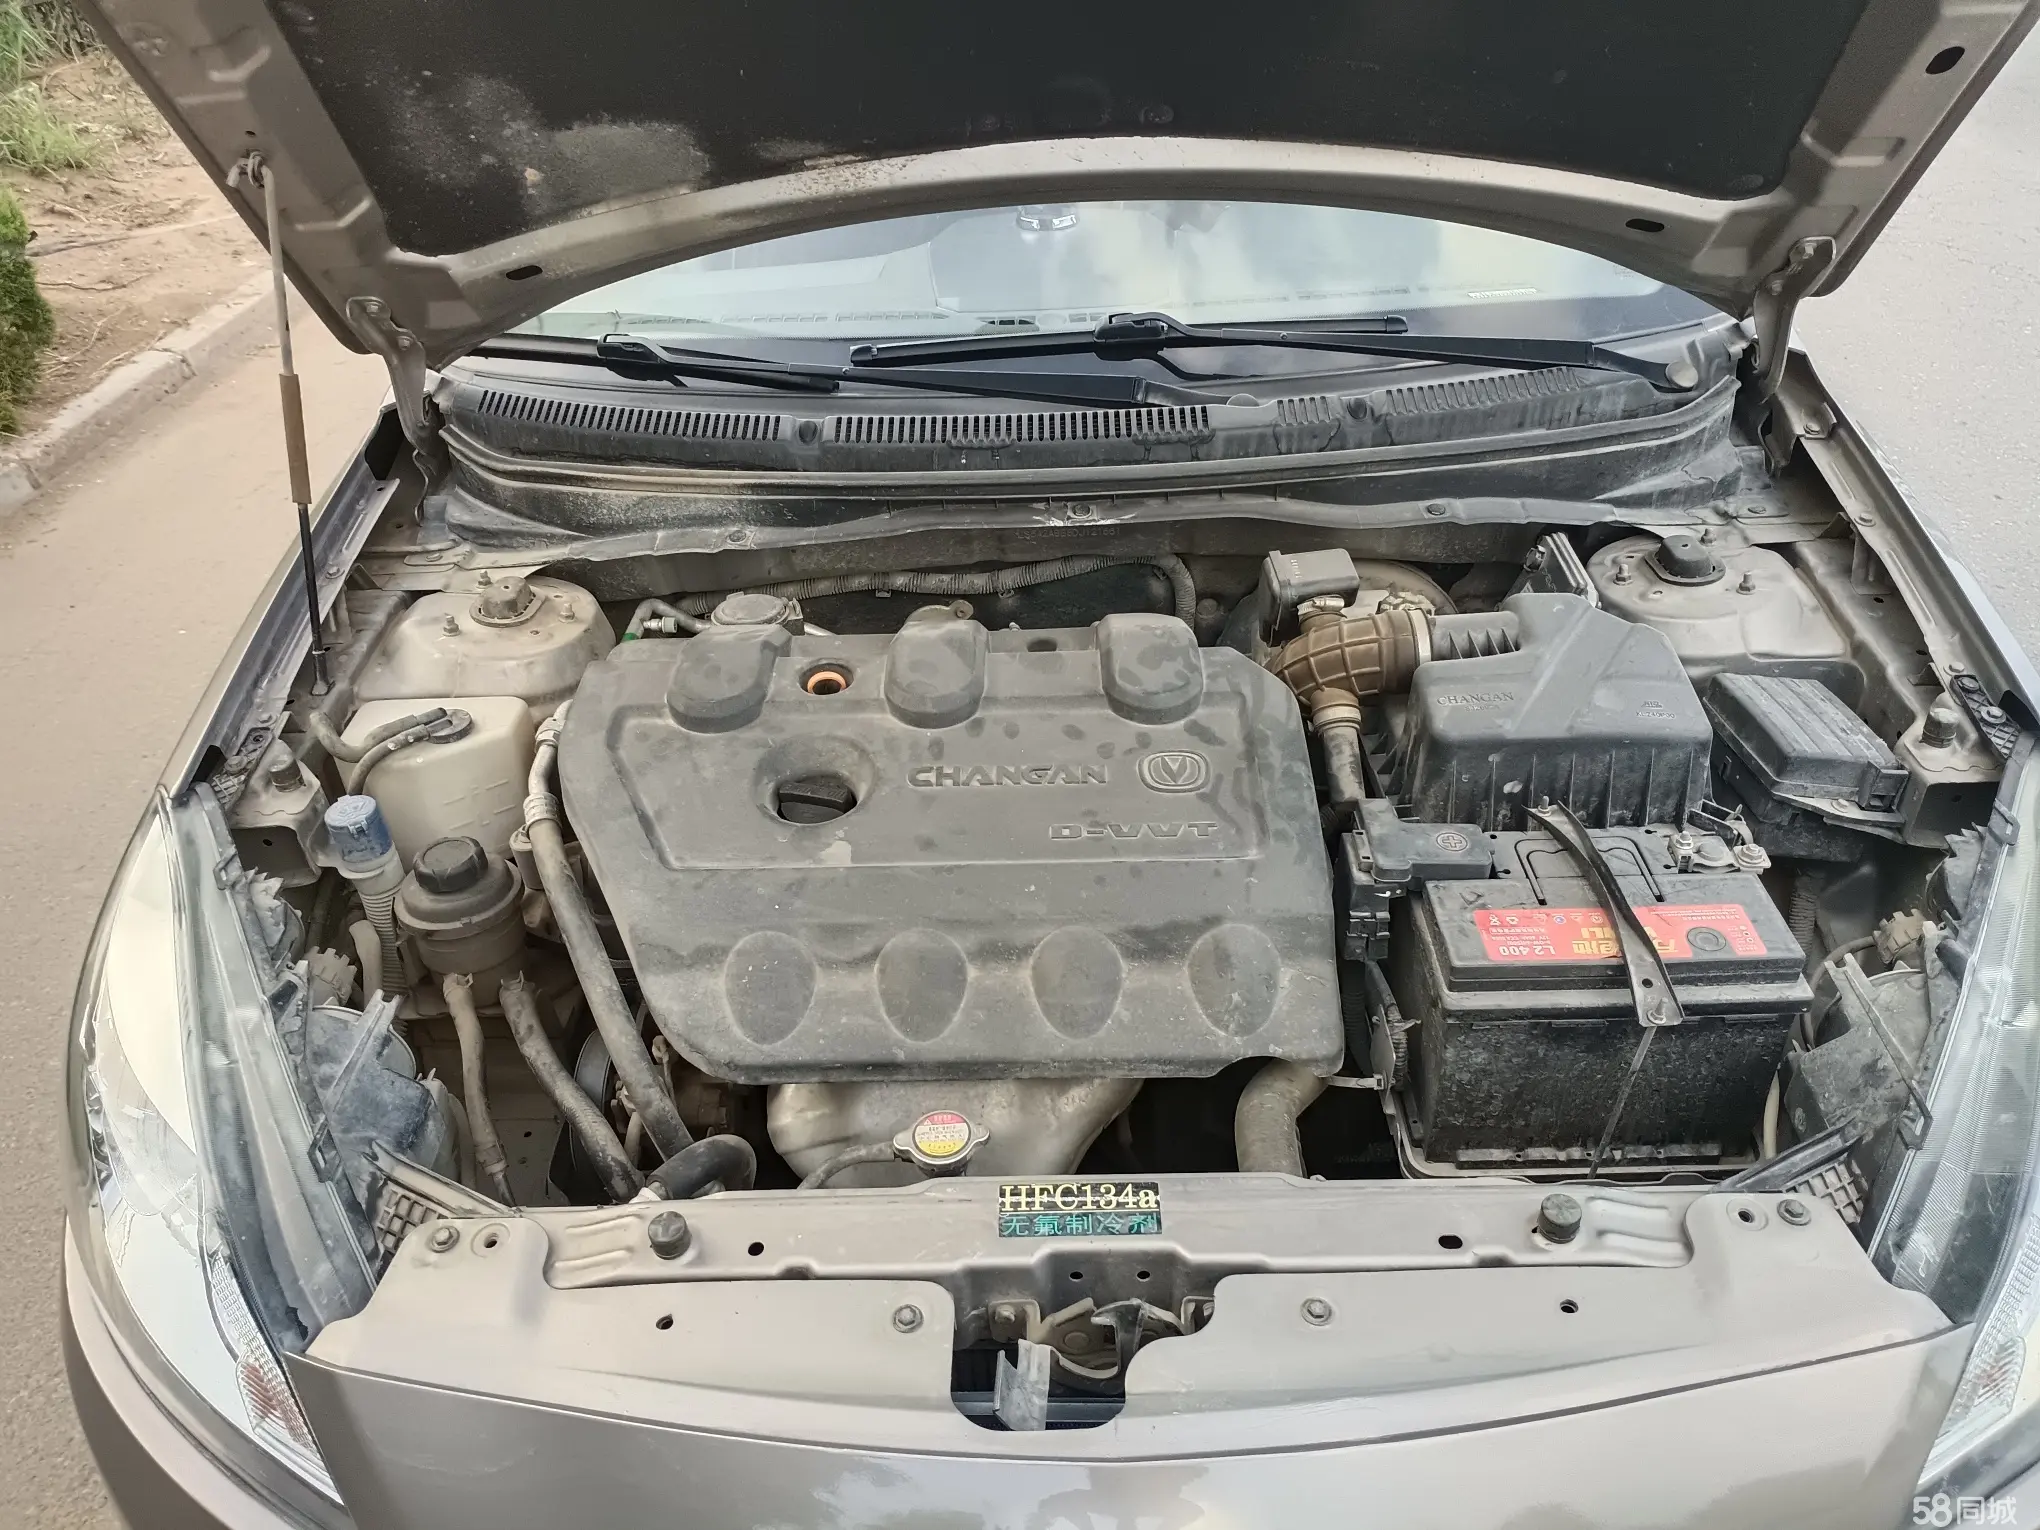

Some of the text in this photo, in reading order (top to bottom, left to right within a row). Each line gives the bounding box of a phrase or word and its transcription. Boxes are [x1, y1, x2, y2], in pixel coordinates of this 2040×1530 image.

[1436, 691, 1514, 706] CHANGAN
[906, 765, 1108, 787] CHANGAN
[1050, 822, 1218, 840] D-VVT
[1498, 945, 1557, 956] L2 400
[1001, 1183, 1159, 1211] HFC134a
[1002, 1213, 1159, 1236] 无氟制冷剂
